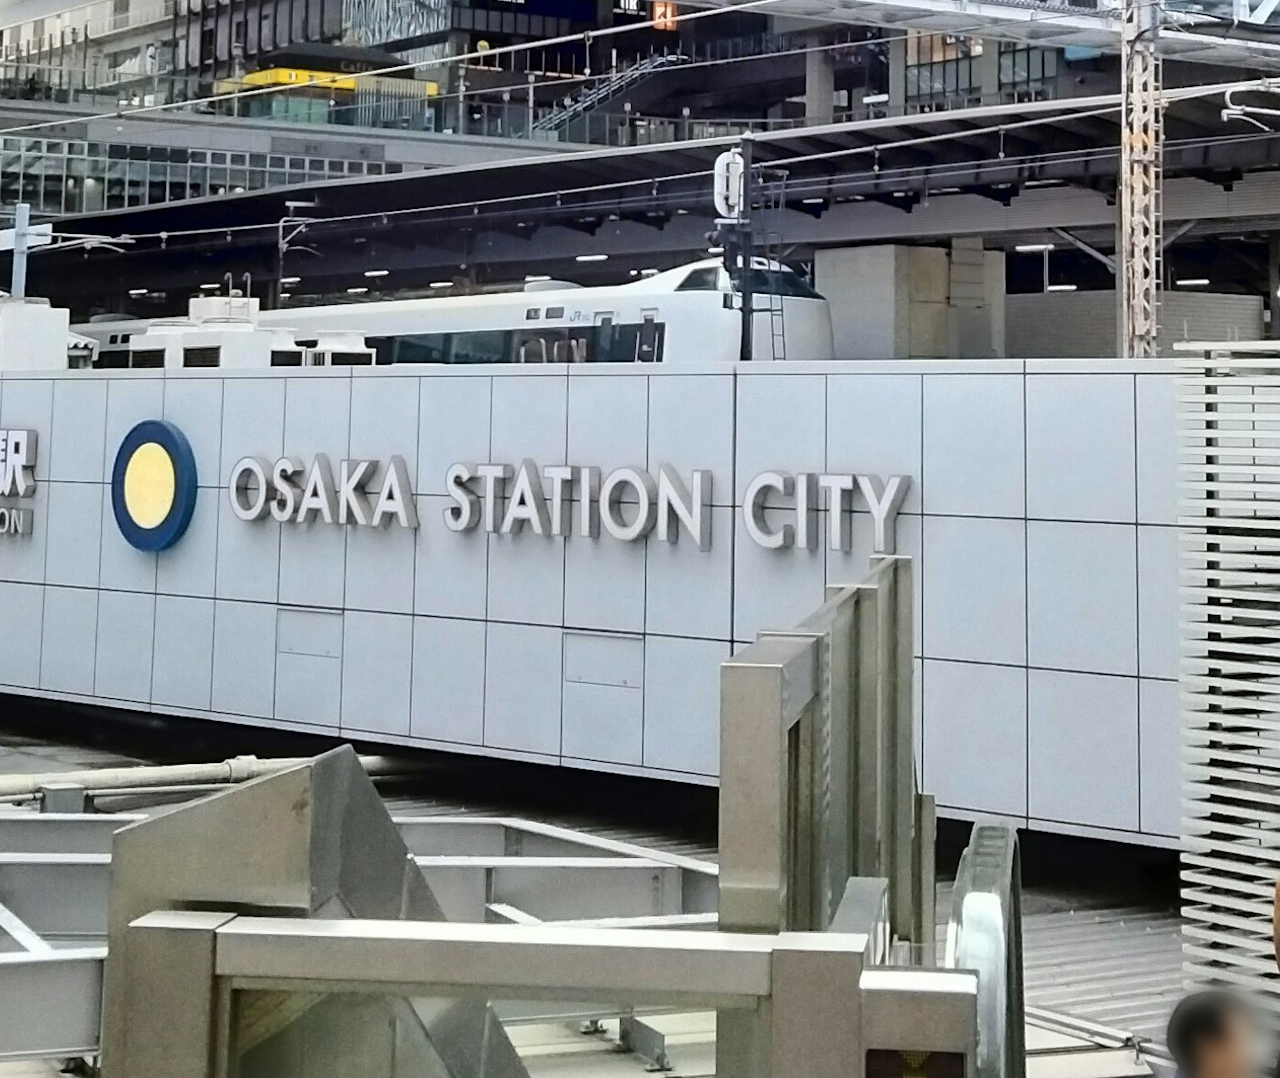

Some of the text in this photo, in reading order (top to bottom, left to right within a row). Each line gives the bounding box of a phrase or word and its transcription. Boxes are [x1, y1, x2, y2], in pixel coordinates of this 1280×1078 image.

[228, 453, 908, 553] OSAKA STATION CITY
